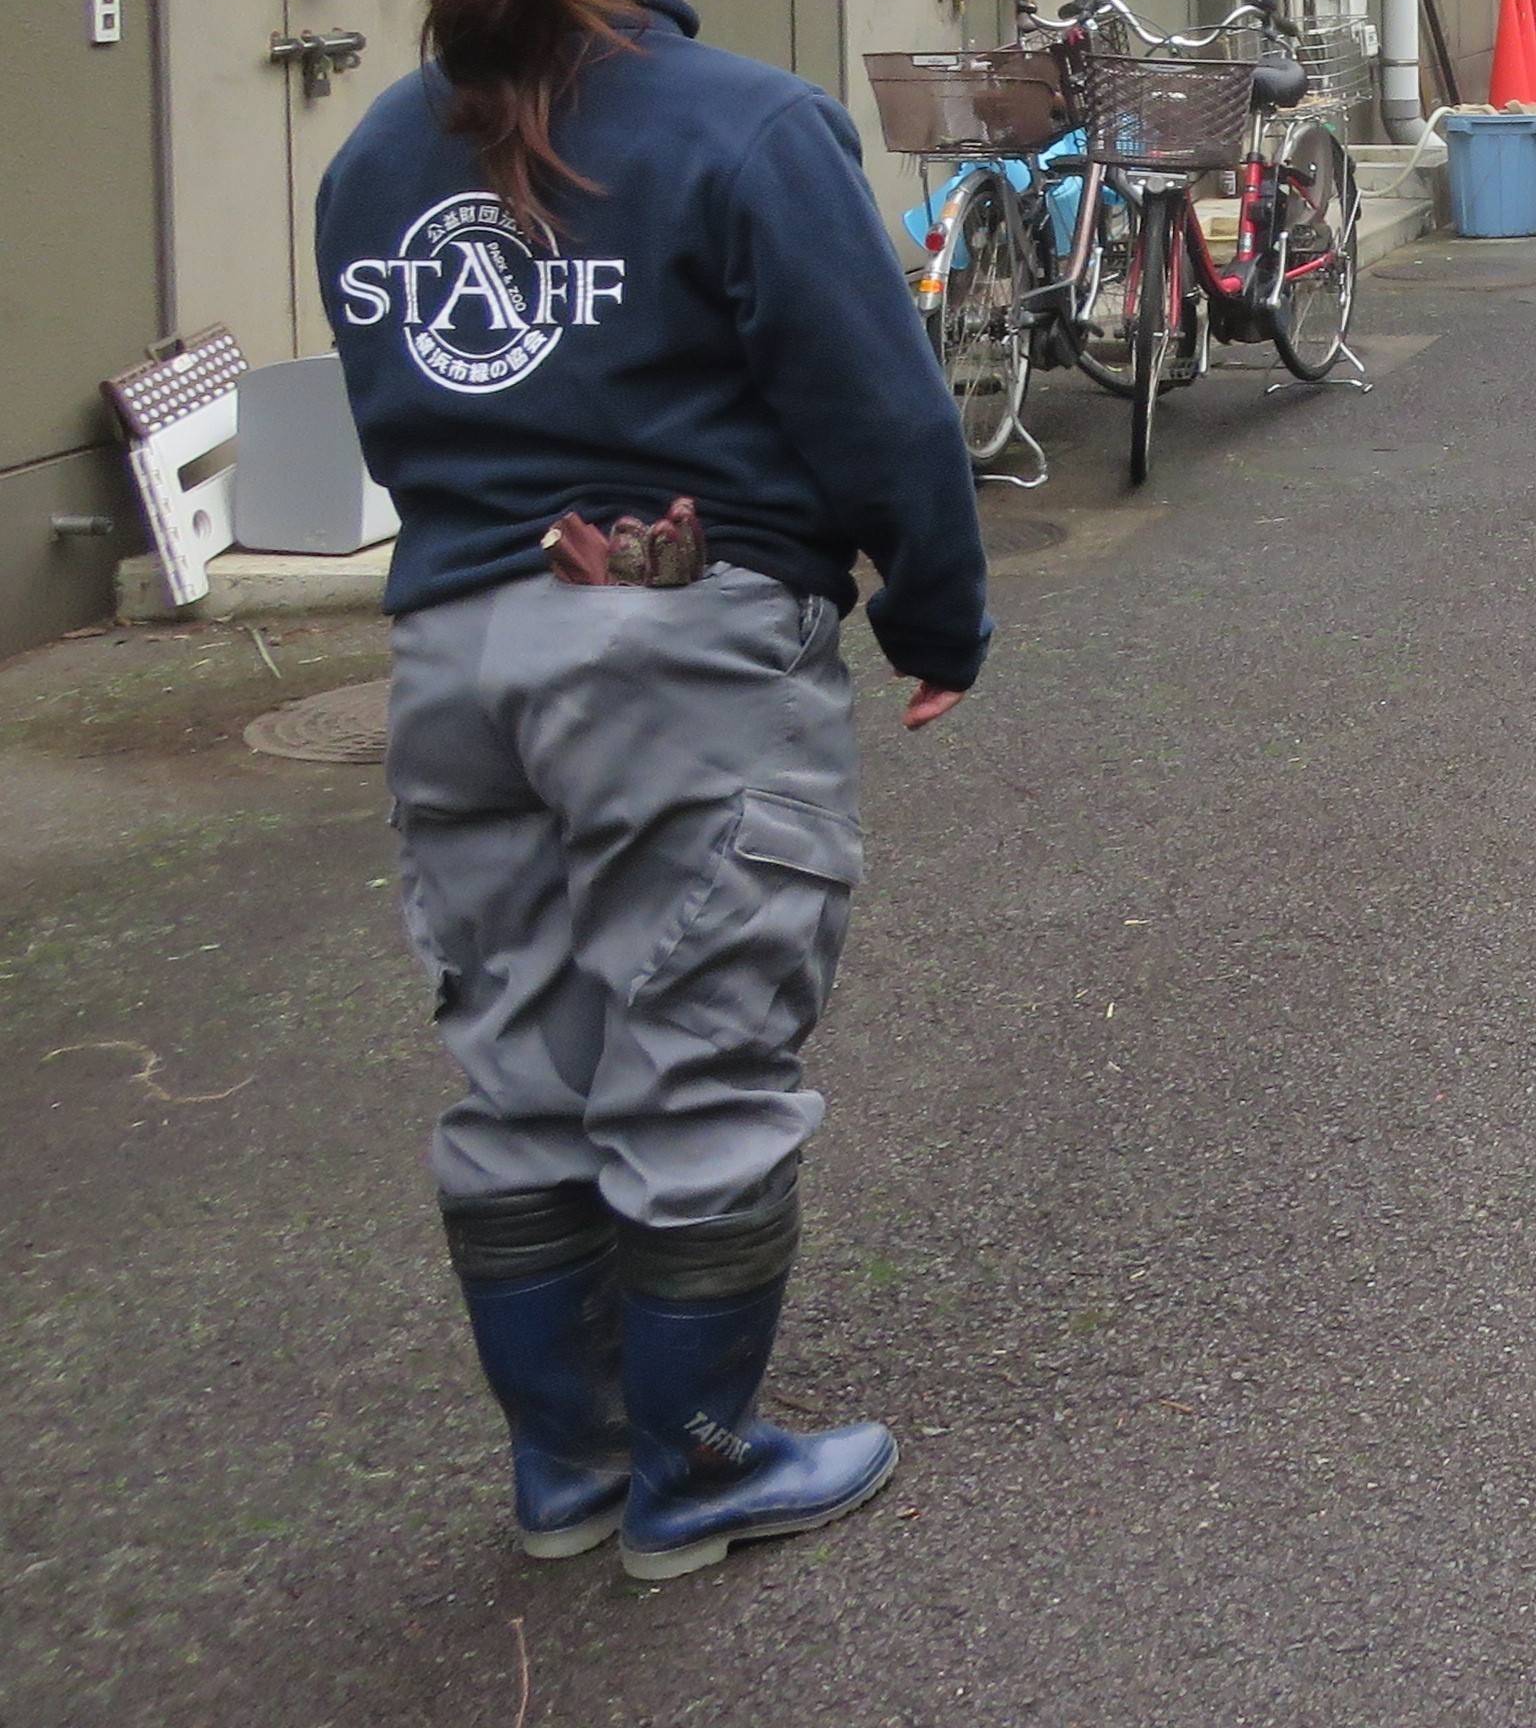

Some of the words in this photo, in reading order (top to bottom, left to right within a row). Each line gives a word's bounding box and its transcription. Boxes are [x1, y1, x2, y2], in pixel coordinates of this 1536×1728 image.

[340, 241, 626, 329] STAFF
[487, 241, 509, 276] PARK
[502, 273, 514, 287] &
[508, 285, 528, 312] ZOO
